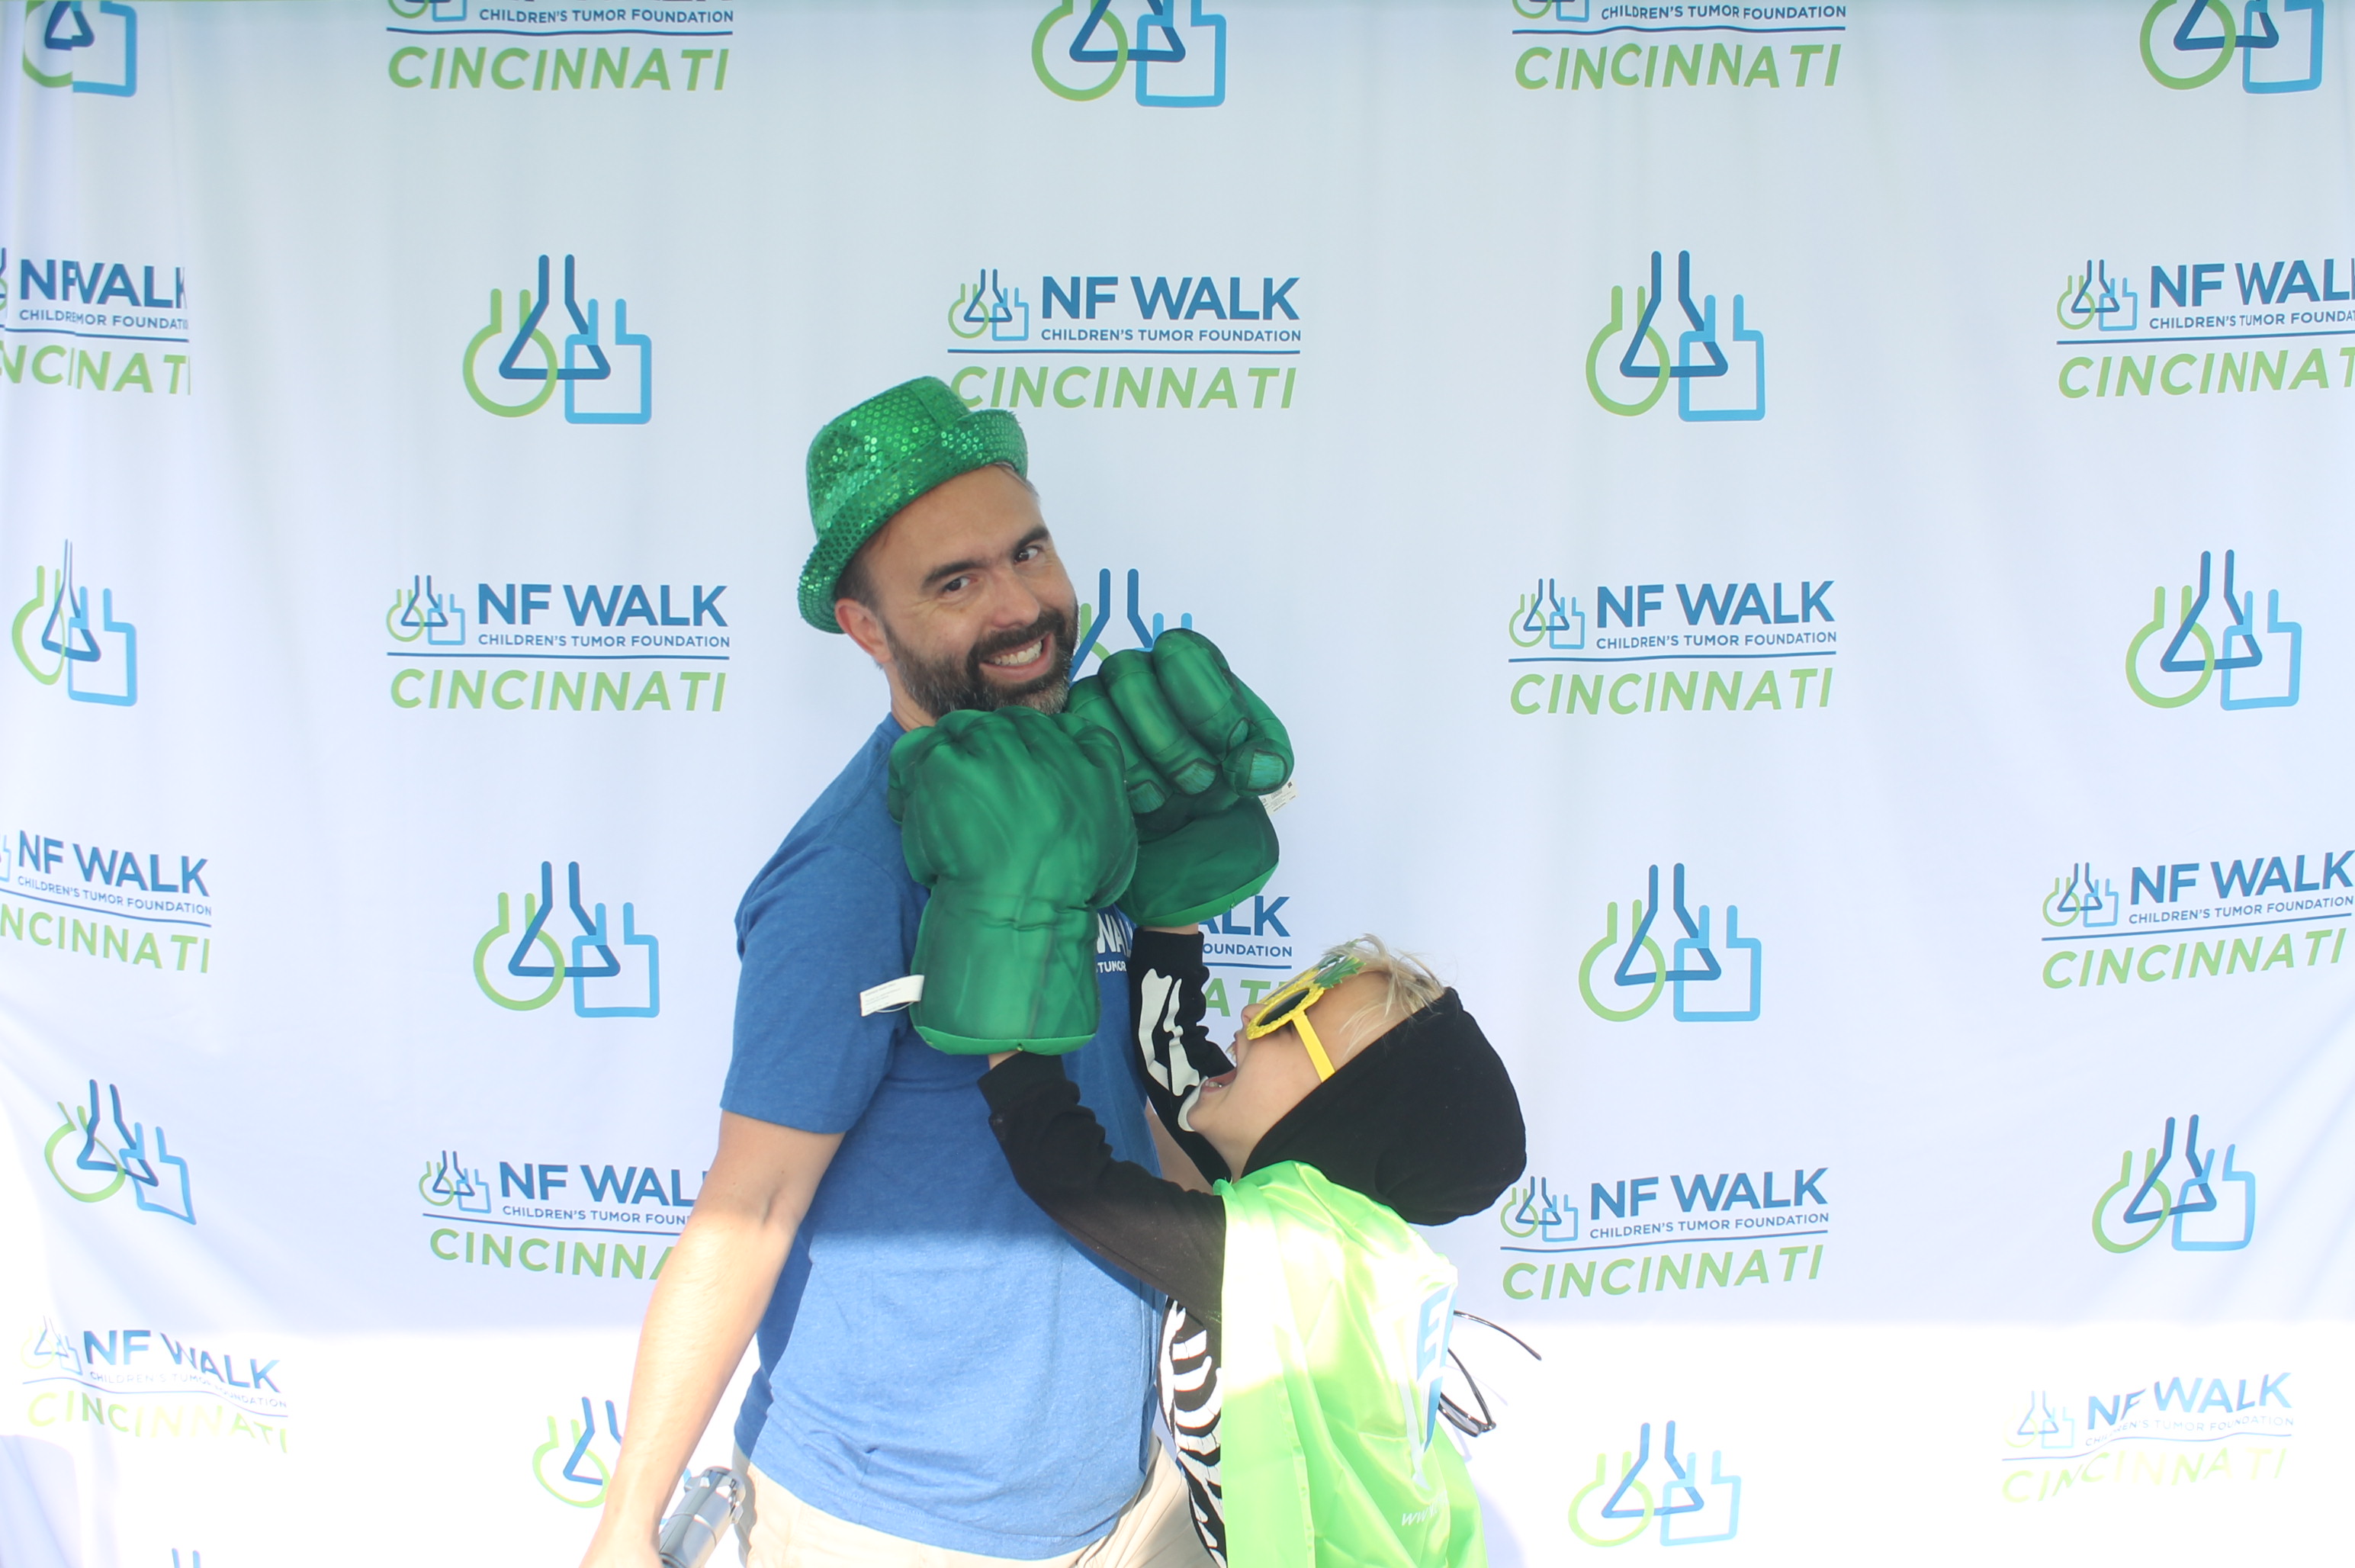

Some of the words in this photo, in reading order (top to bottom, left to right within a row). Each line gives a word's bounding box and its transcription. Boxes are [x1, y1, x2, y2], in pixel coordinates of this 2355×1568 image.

[480, 8, 567, 23] CHILDREN'S
[573, 9, 625, 21] TUMOR
[631, 9, 733, 23] FOUNDATION
[1602, 5, 1683, 21] CHILDREN'S
[1688, 4, 1740, 18] TUMOR
[1743, 5, 1846, 20] FOUNDATION
[388, 46, 729, 91] CINCINNATI
[1515, 43, 1842, 90] CINCINNATI
[1042, 276, 1119, 319] NF
[1130, 276, 1300, 320] WALK
[2150, 263, 2225, 308] NF
[2235, 258, 2355, 305] WAL
[1041, 328, 1133, 342] CHILDREN'S
[1138, 329, 1194, 342] TUMOR
[1199, 329, 1302, 343] FOUNDATION
[2149, 315, 2236, 329] CHILDREN'S
[2240, 313, 2285, 326] TUMOR
[950, 365, 1297, 410] CINCINNATI
[478, 583, 552, 625] NF
[563, 584, 729, 627] WALK
[1597, 584, 1664, 628] NF
[1675, 580, 1836, 625] WALK
[477, 634, 567, 647] CHILDREN'S
[571, 635, 625, 647] TUMOR
[631, 636, 730, 647] FOUNDATION
[1596, 635, 1679, 650] CHILDREN'S
[1684, 634, 1740, 647] TUMOR
[1744, 631, 1836, 647] FOUNDATION
[390, 668, 727, 712] CINCINNATI
[1510, 667, 1833, 715] CINCINNATI
[18, 830, 64, 875] NF
[72, 843, 210, 898] WALK
[2130, 863, 2199, 905] NF
[2210, 850, 2355, 899] WALK
[18, 876, 80, 898] CHILDREN'S
[82, 889, 124, 906] TUMOR
[127, 898, 212, 916] FOUNDATION
[2128, 908, 2210, 924] CHILDREN'S
[2215, 904, 2263, 918] TUMOR
[2267, 895, 2354, 914] FOUNDATION
[1097, 961, 1127, 973] TUMOR
[1203, 943, 1293, 957] OUNDATION
[2042, 927, 2347, 989] CINCINNATI
[499, 1161, 568, 1200] NF
[580, 1165, 708, 1207] WAL
[1591, 1176, 1659, 1220] NF
[1670, 1167, 1829, 1213] WALK
[502, 1205, 586, 1220] CHILDREN'S
[590, 1210, 641, 1223] TUMOR
[1589, 1222, 1674, 1239] CHILDREN'S
[1678, 1219, 1730, 1232] TUMOR
[1735, 1213, 1829, 1229] FOUNDATION
[1502, 1244, 1823, 1300] CINCINNATI
[83, 1329, 152, 1365] NF
[159, 1332, 281, 1393] WALK
[2087, 1388, 2147, 1430] NF
[2154, 1372, 2293, 1413] WALK
[2154, 1419, 2205, 1431] TUMOR
[2209, 1415, 2294, 1431] FOUNDATION
